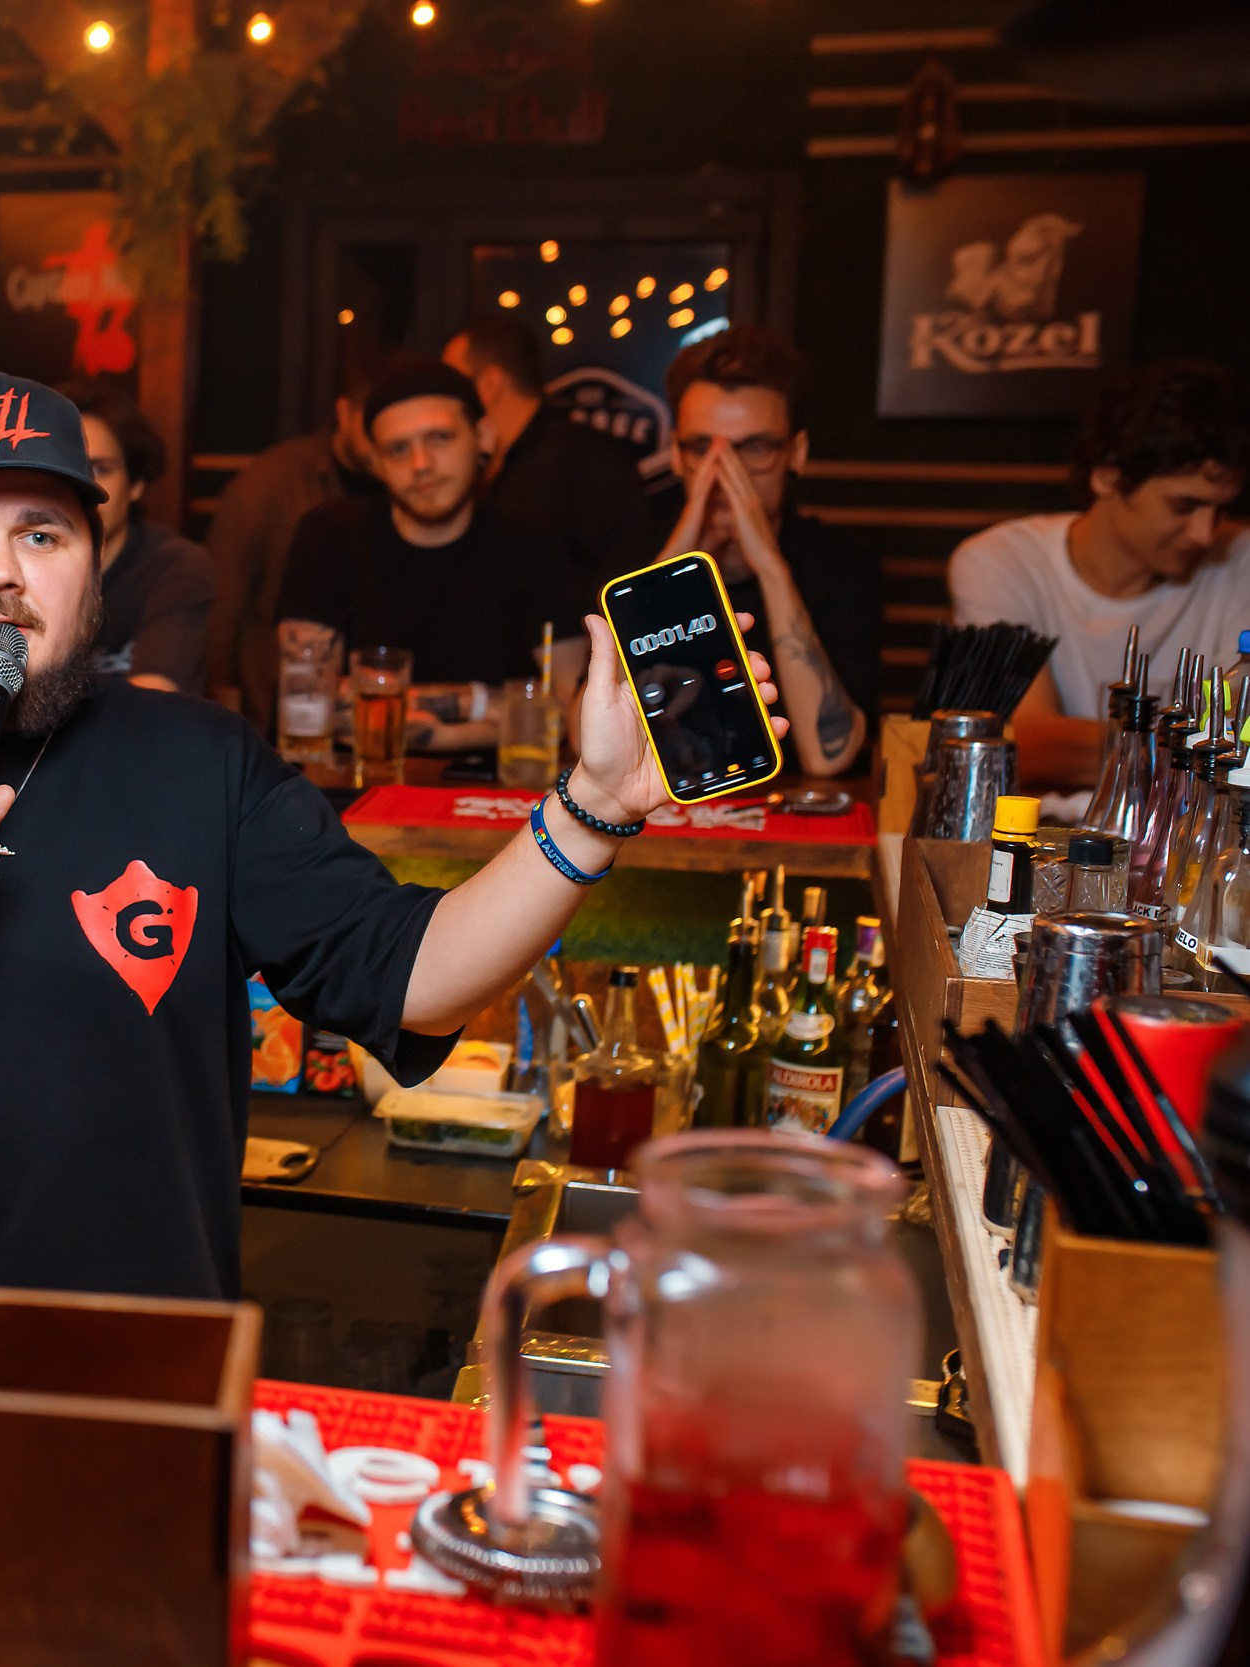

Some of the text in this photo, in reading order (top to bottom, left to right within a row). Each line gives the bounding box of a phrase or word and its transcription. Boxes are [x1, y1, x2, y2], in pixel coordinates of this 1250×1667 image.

[909, 311, 1100, 373] Kozel
[541, 843, 577, 879] AUTISM
[116, 900, 175, 960] G
[1177, 929, 1197, 949] ELO
